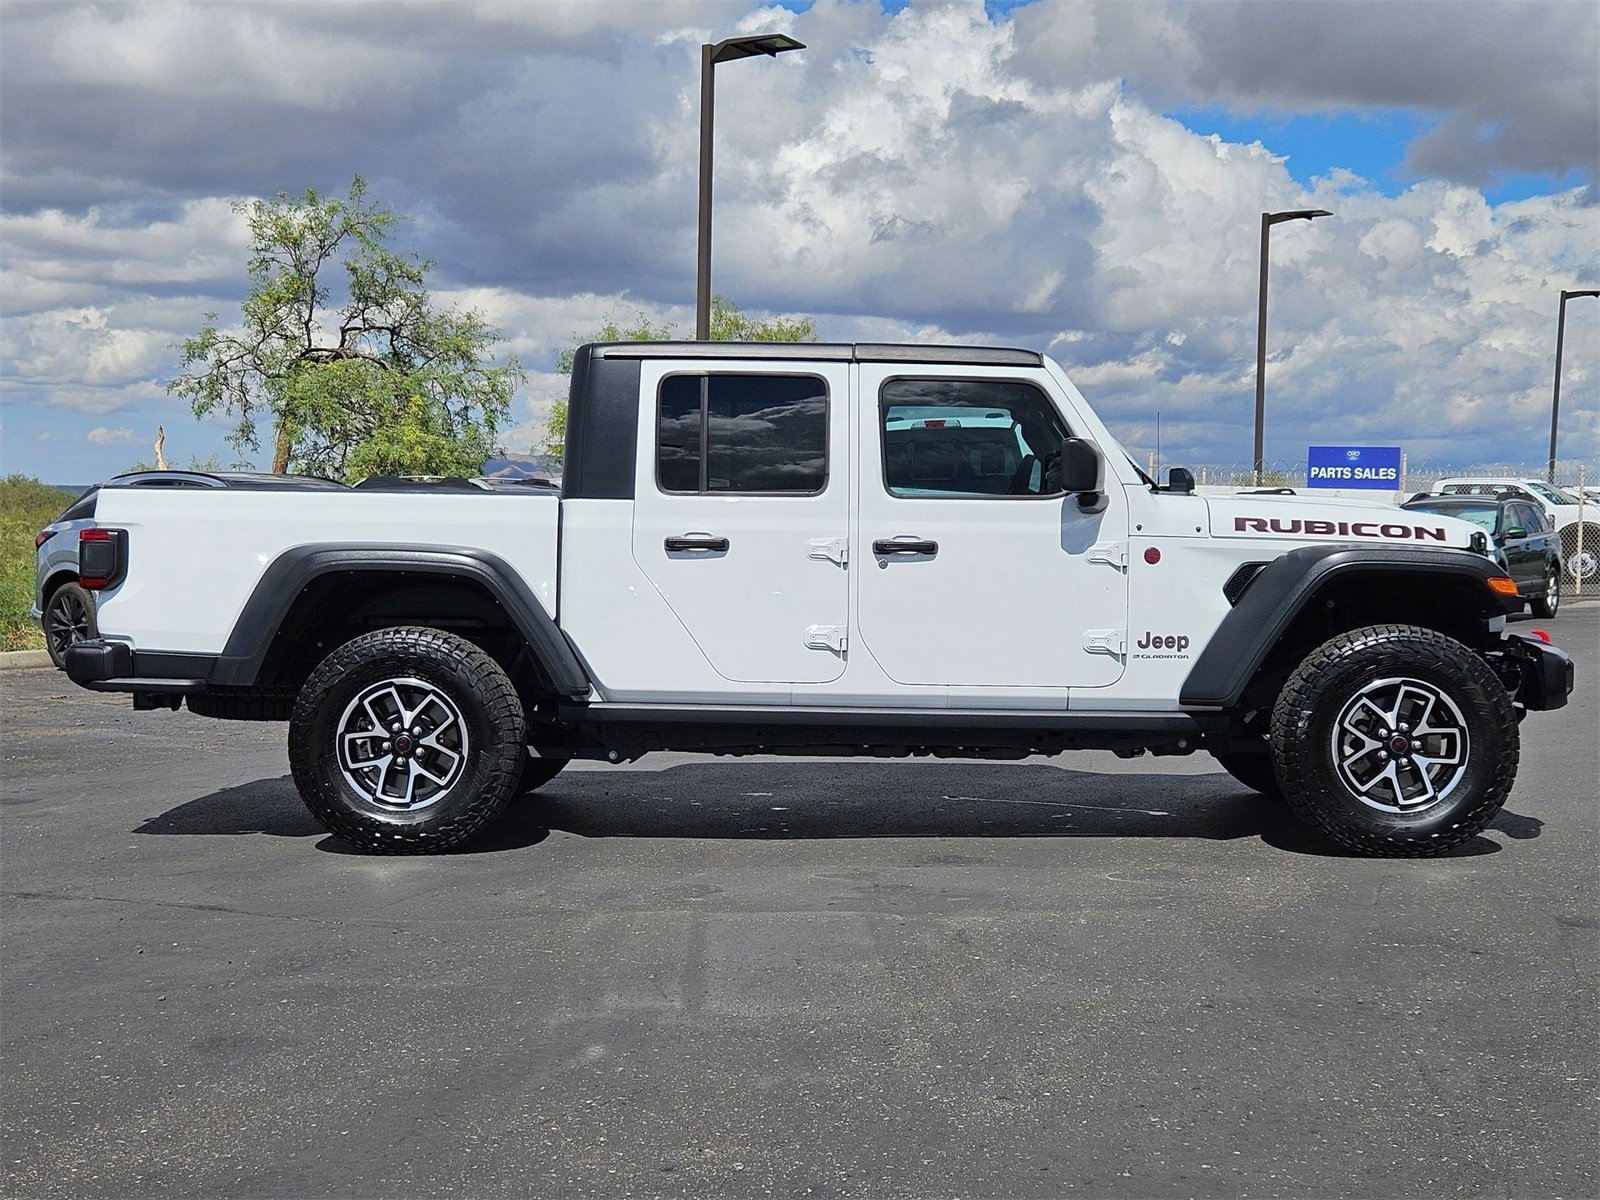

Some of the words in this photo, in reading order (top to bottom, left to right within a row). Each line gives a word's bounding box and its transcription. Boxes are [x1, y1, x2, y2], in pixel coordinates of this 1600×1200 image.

[1310, 467, 1352, 479] PARTS
[1354, 467, 1397, 480] SALES
[1234, 517, 1447, 541] RUBICON
[1137, 631, 1190, 653] Jeep
